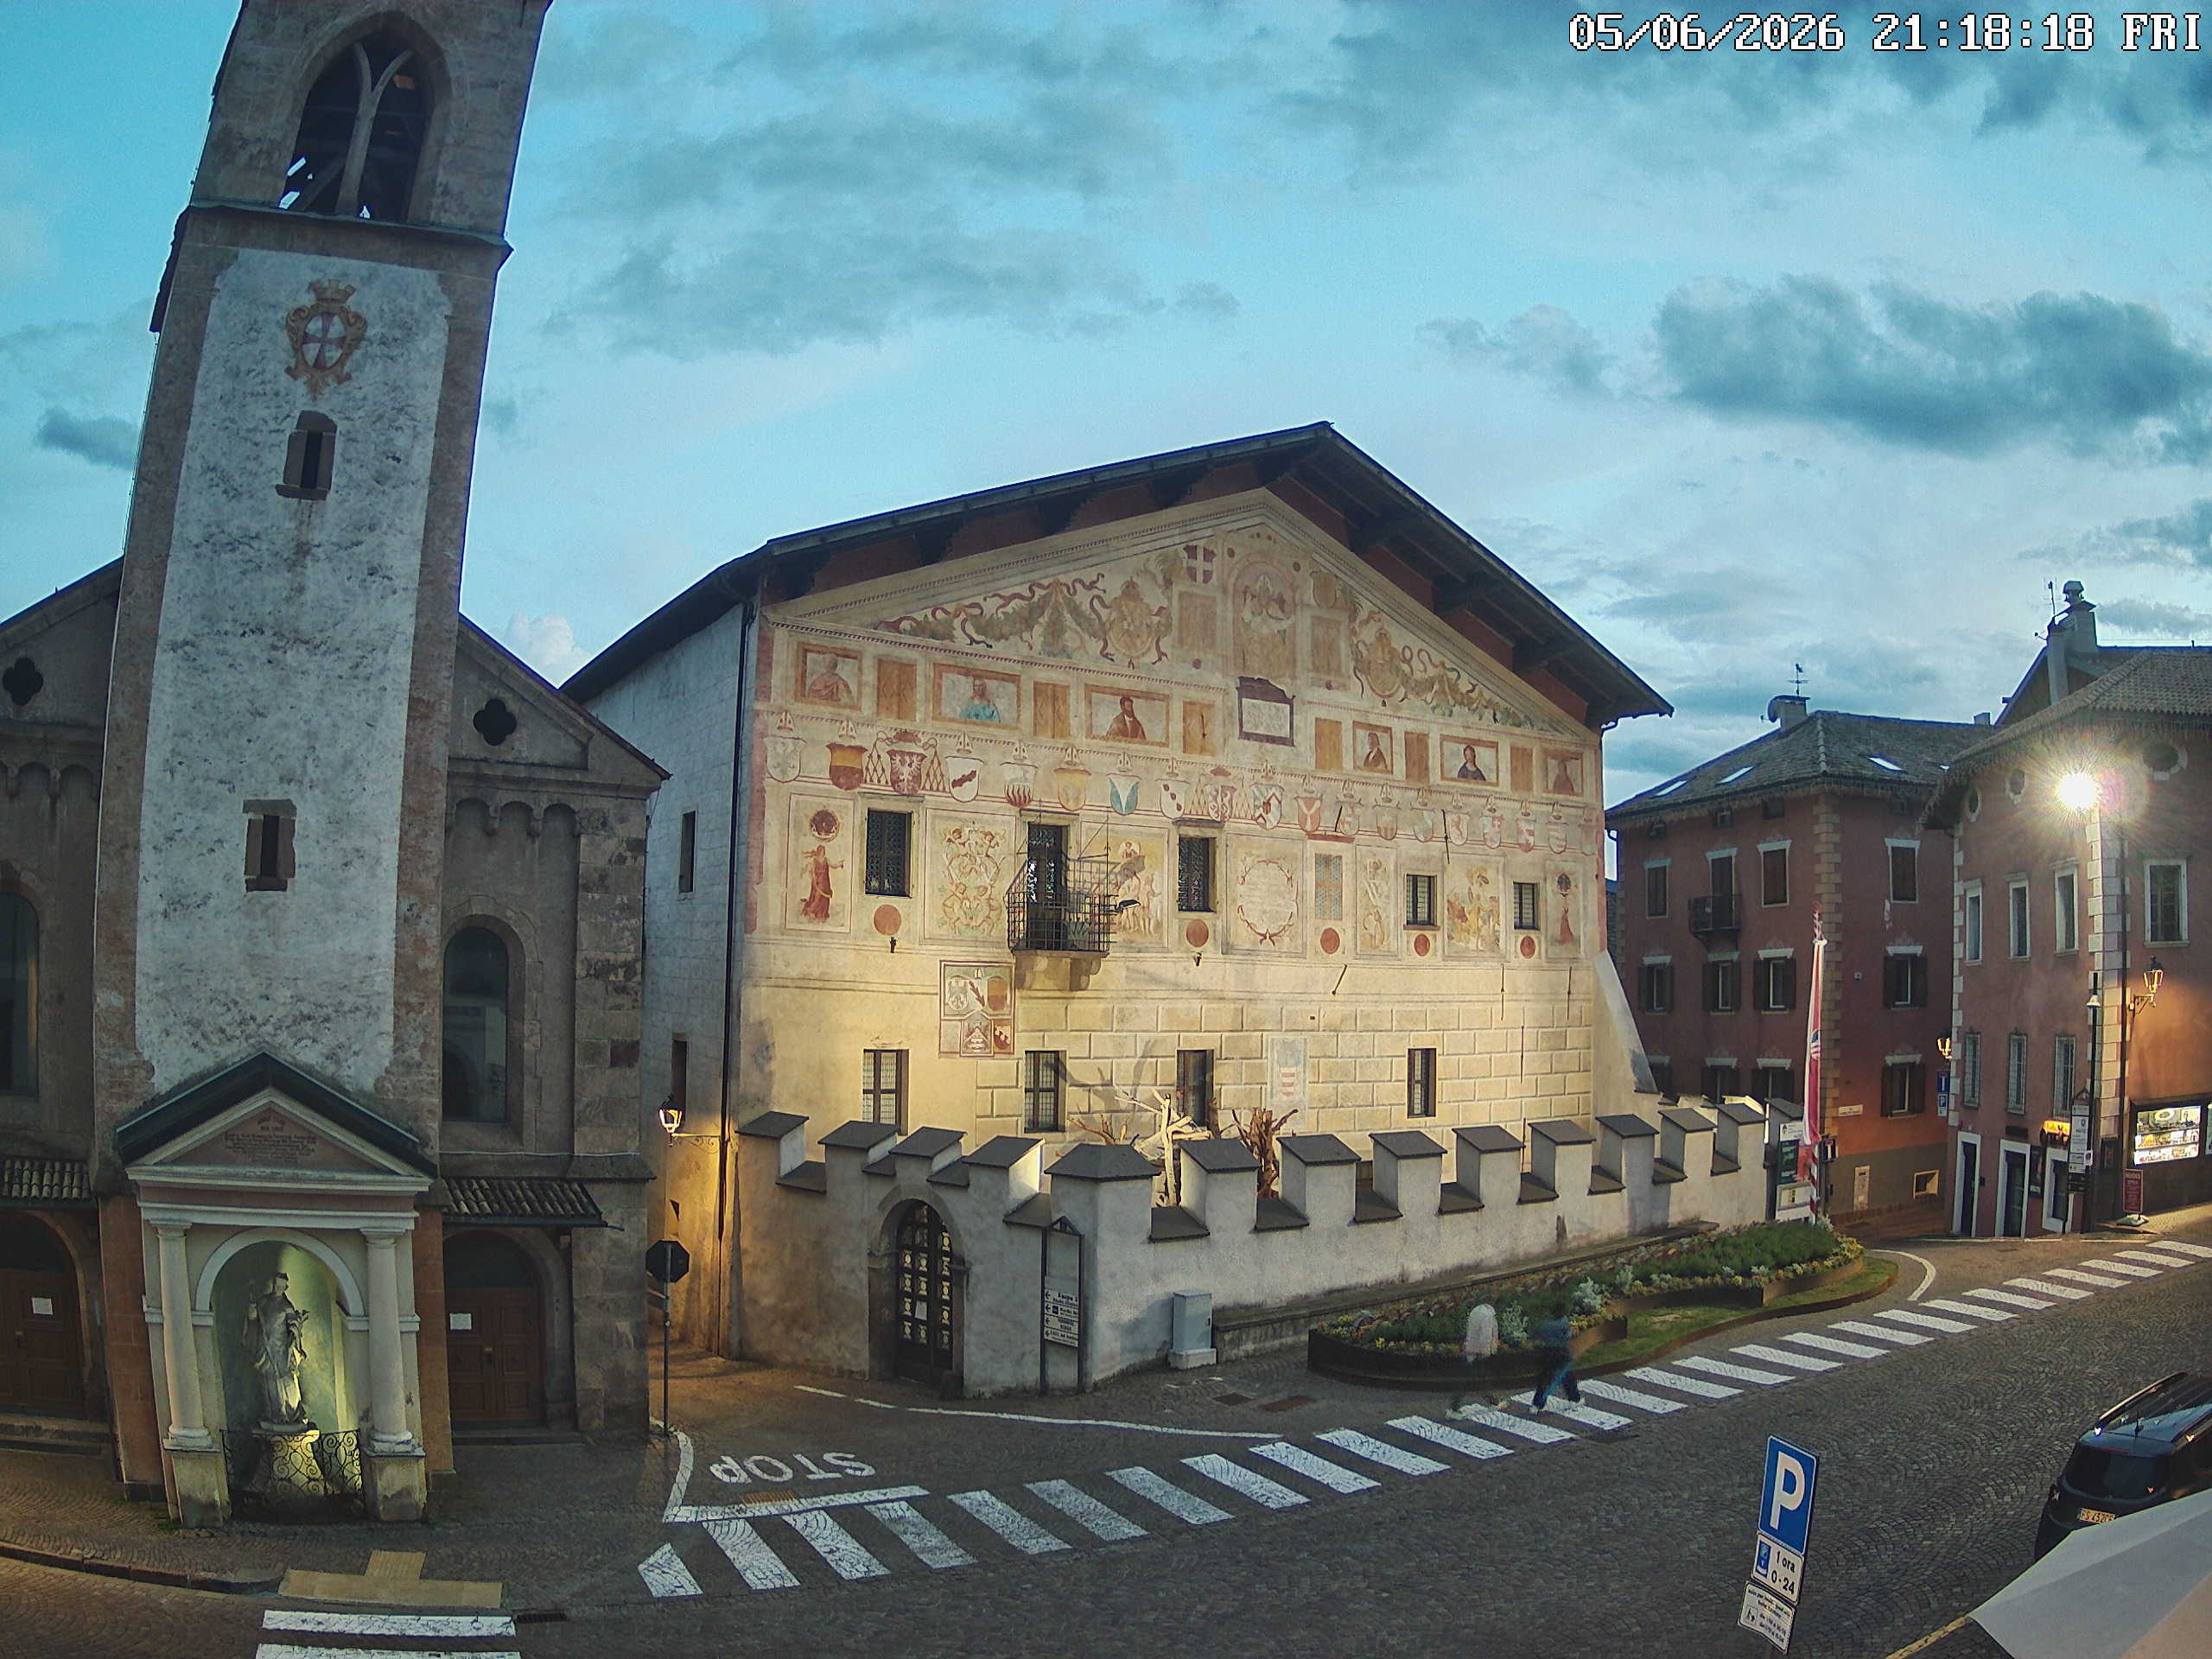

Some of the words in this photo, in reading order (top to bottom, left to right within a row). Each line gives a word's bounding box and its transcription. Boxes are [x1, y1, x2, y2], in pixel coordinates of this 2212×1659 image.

[709, 1452, 876, 1484] STOP
[1770, 1451, 1805, 1530] P
[1782, 1557, 1796, 1573] ora
